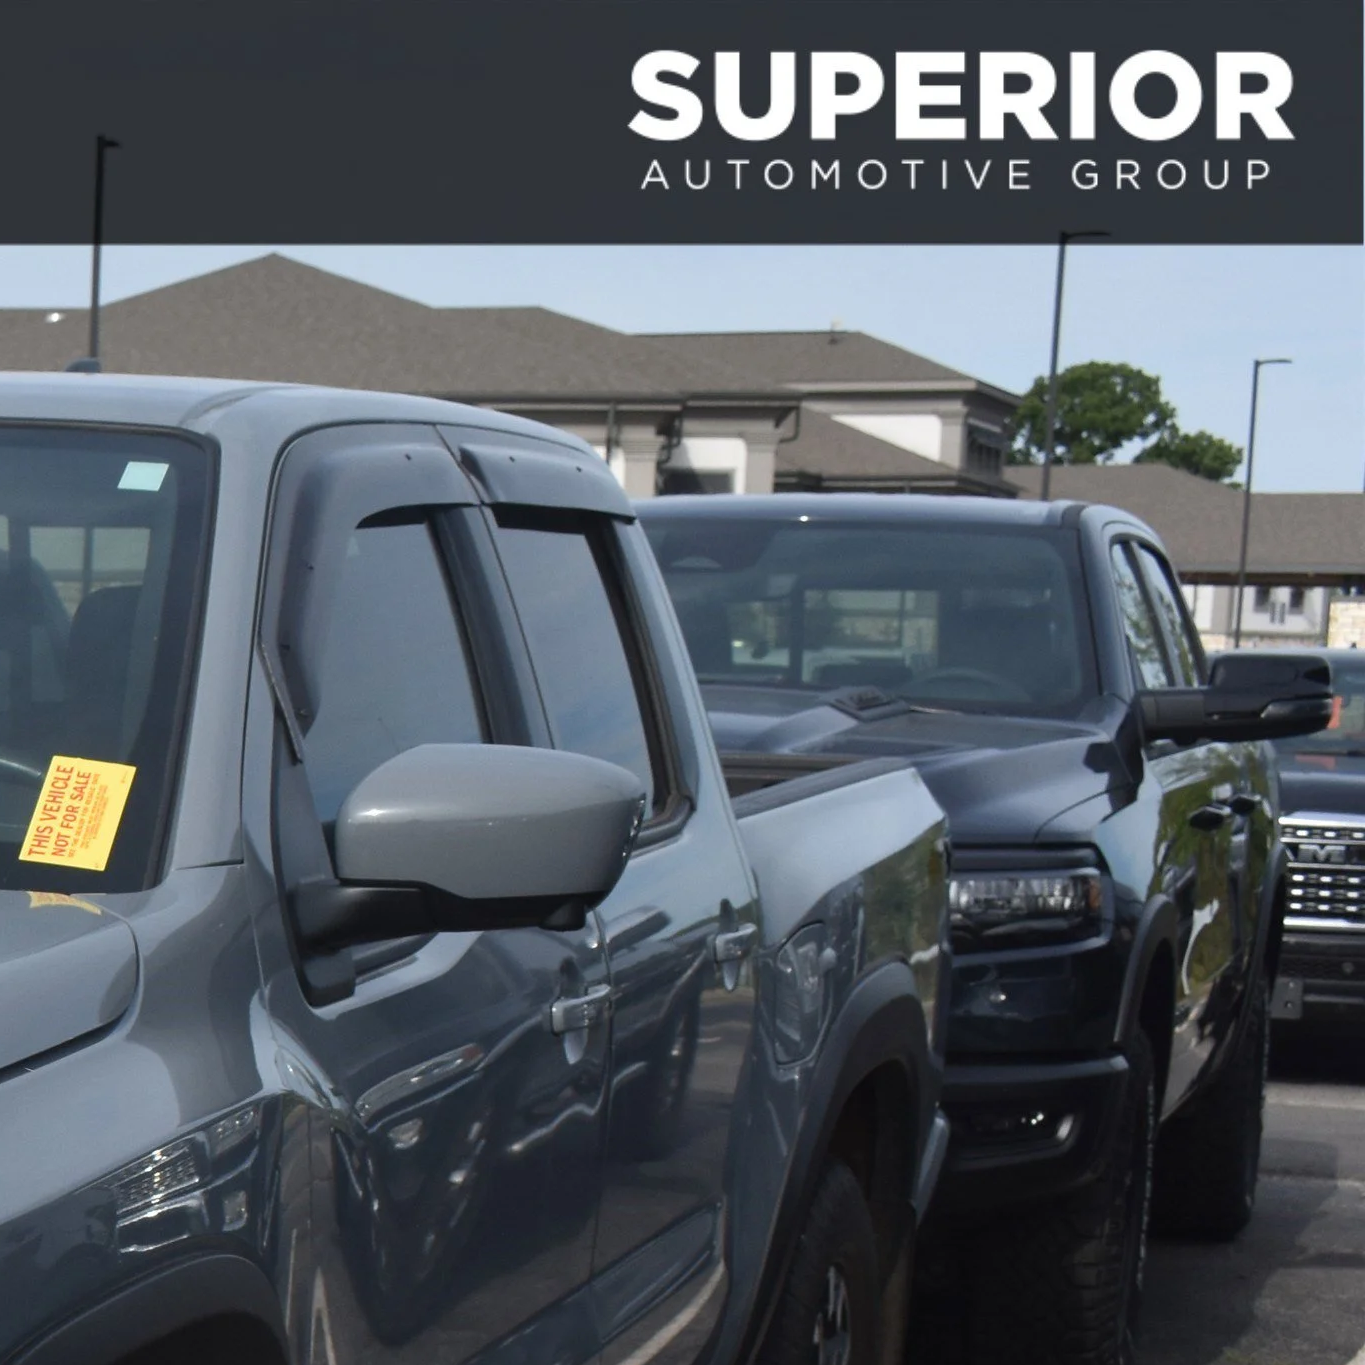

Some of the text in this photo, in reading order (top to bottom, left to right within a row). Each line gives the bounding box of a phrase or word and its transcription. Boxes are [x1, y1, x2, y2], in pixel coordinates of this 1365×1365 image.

[70, 771, 92, 801] SALE
[27, 765, 74, 857] THIS VEHICLE
[60, 804, 80, 829] FOR
[51, 832, 71, 857] NOT
